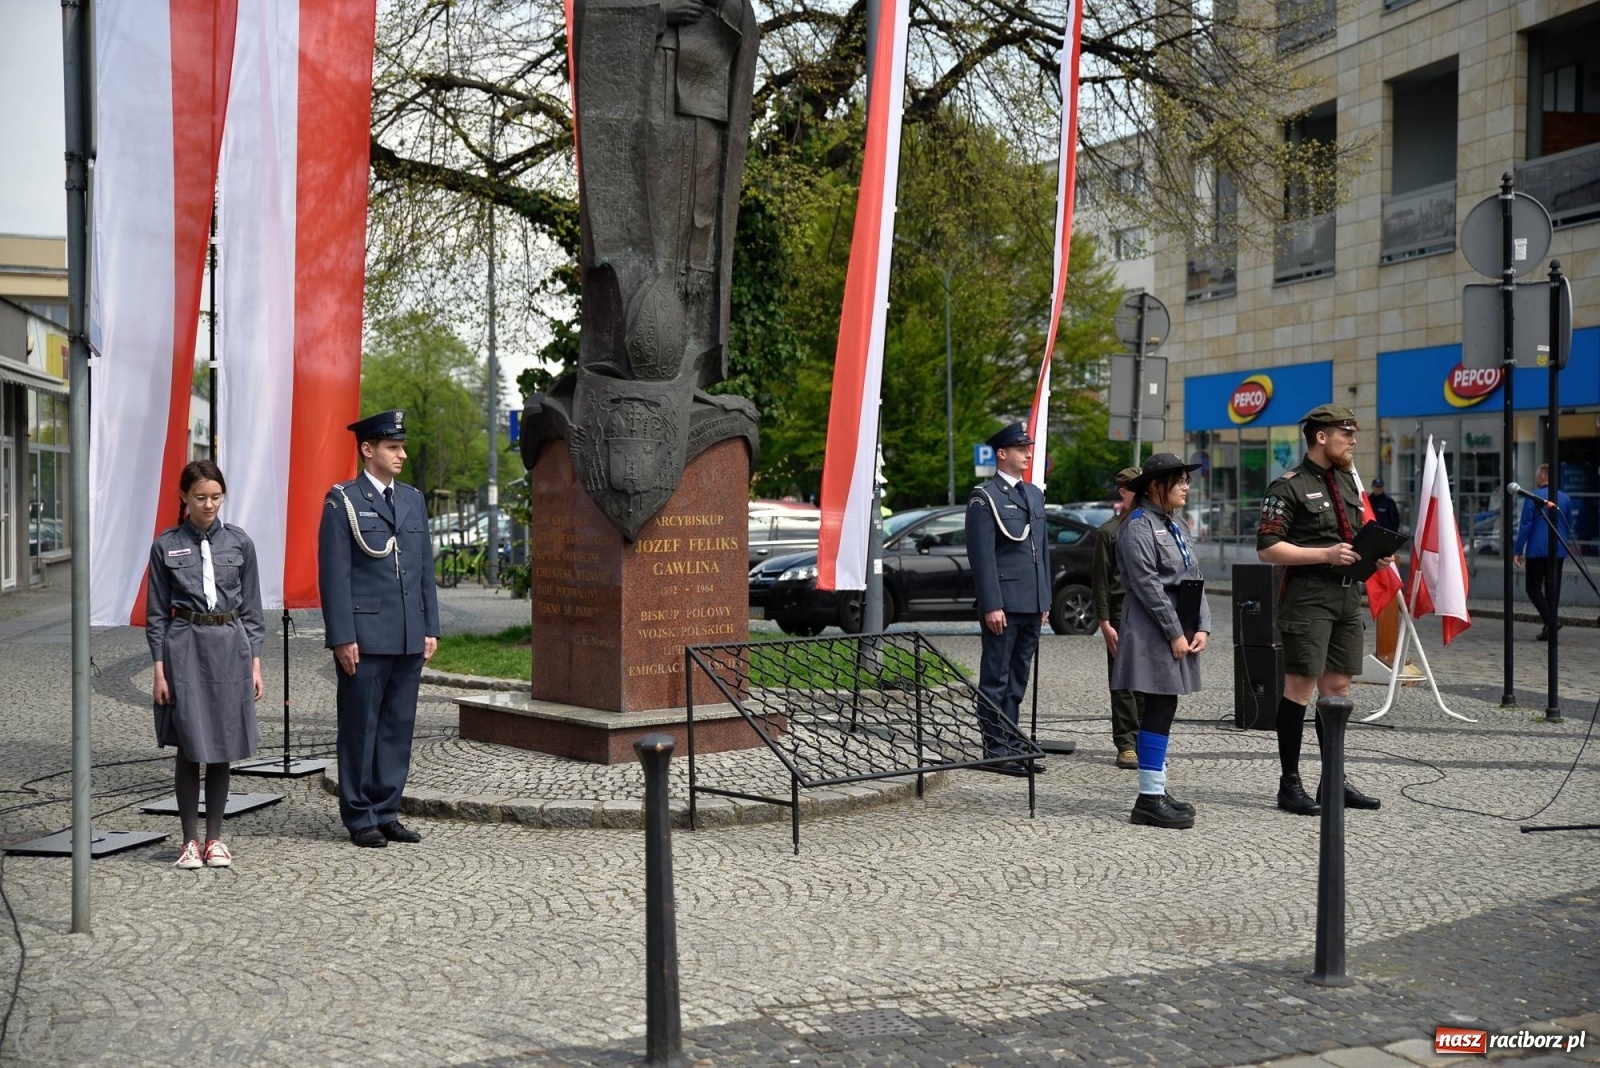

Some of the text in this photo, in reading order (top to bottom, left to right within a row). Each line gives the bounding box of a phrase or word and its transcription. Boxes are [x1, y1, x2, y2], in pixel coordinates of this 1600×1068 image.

[1453, 368, 1496, 387] PEPCO
[1234, 391, 1263, 408] PEPCO
[979, 446, 992, 464] P
[654, 515, 724, 527] ARCYBISKUP
[689, 537, 738, 551] FELIKS
[653, 560, 720, 575] GAWLINA
[696, 584, 714, 593] 1964
[640, 606, 733, 621] BISKUP POLOWY
[639, 624, 734, 639] WOJSK POLSKICH
